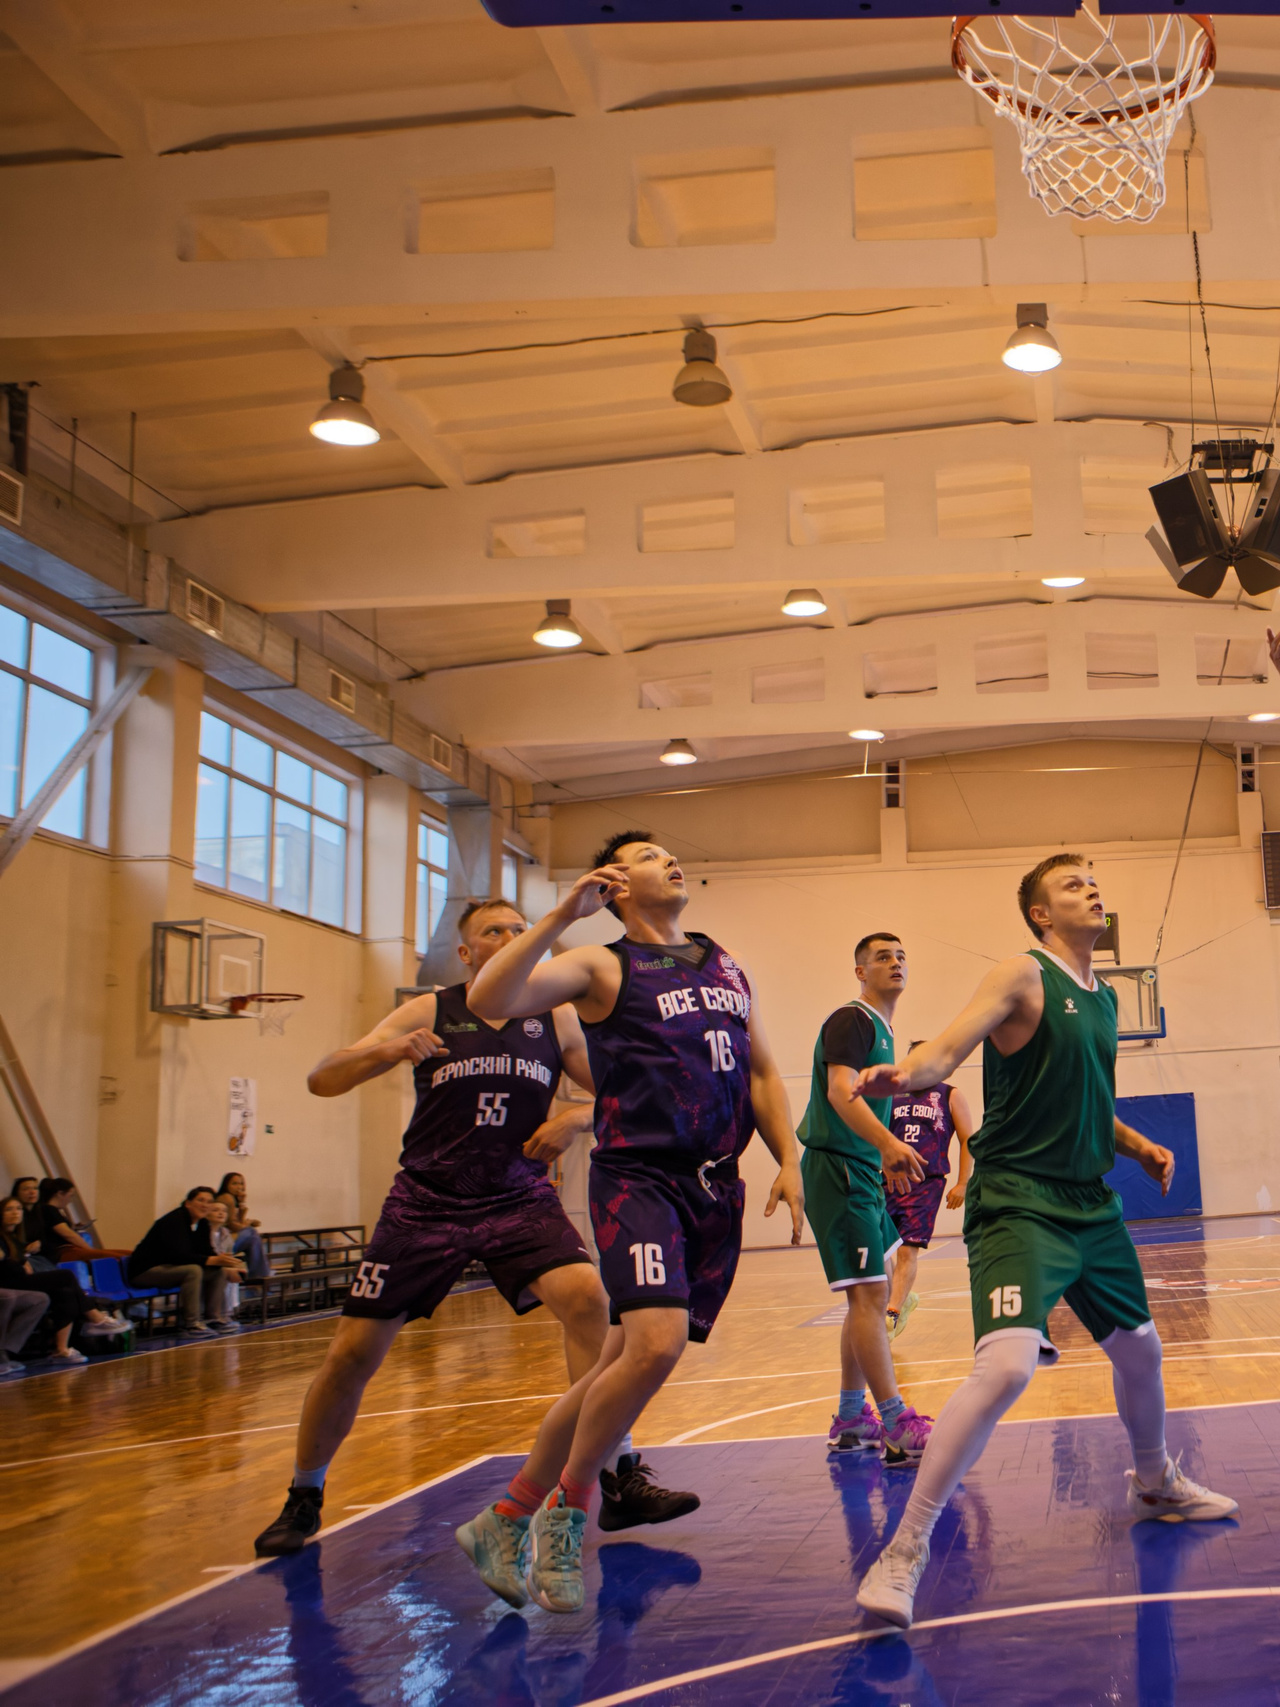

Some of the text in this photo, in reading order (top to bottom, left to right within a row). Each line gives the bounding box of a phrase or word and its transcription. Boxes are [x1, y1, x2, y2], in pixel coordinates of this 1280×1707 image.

[656, 987, 700, 1022] ВСЕ
[704, 1030, 736, 1072] 16
[431, 1053, 512, 1089] ПЕРМСКИЙ
[475, 1092, 511, 1126] 55
[904, 1124, 920, 1143] 22
[629, 1242, 667, 1286] 16
[857, 1247, 869, 1270] 7
[350, 1260, 391, 1299] 55
[989, 1285, 1022, 1319] 15
